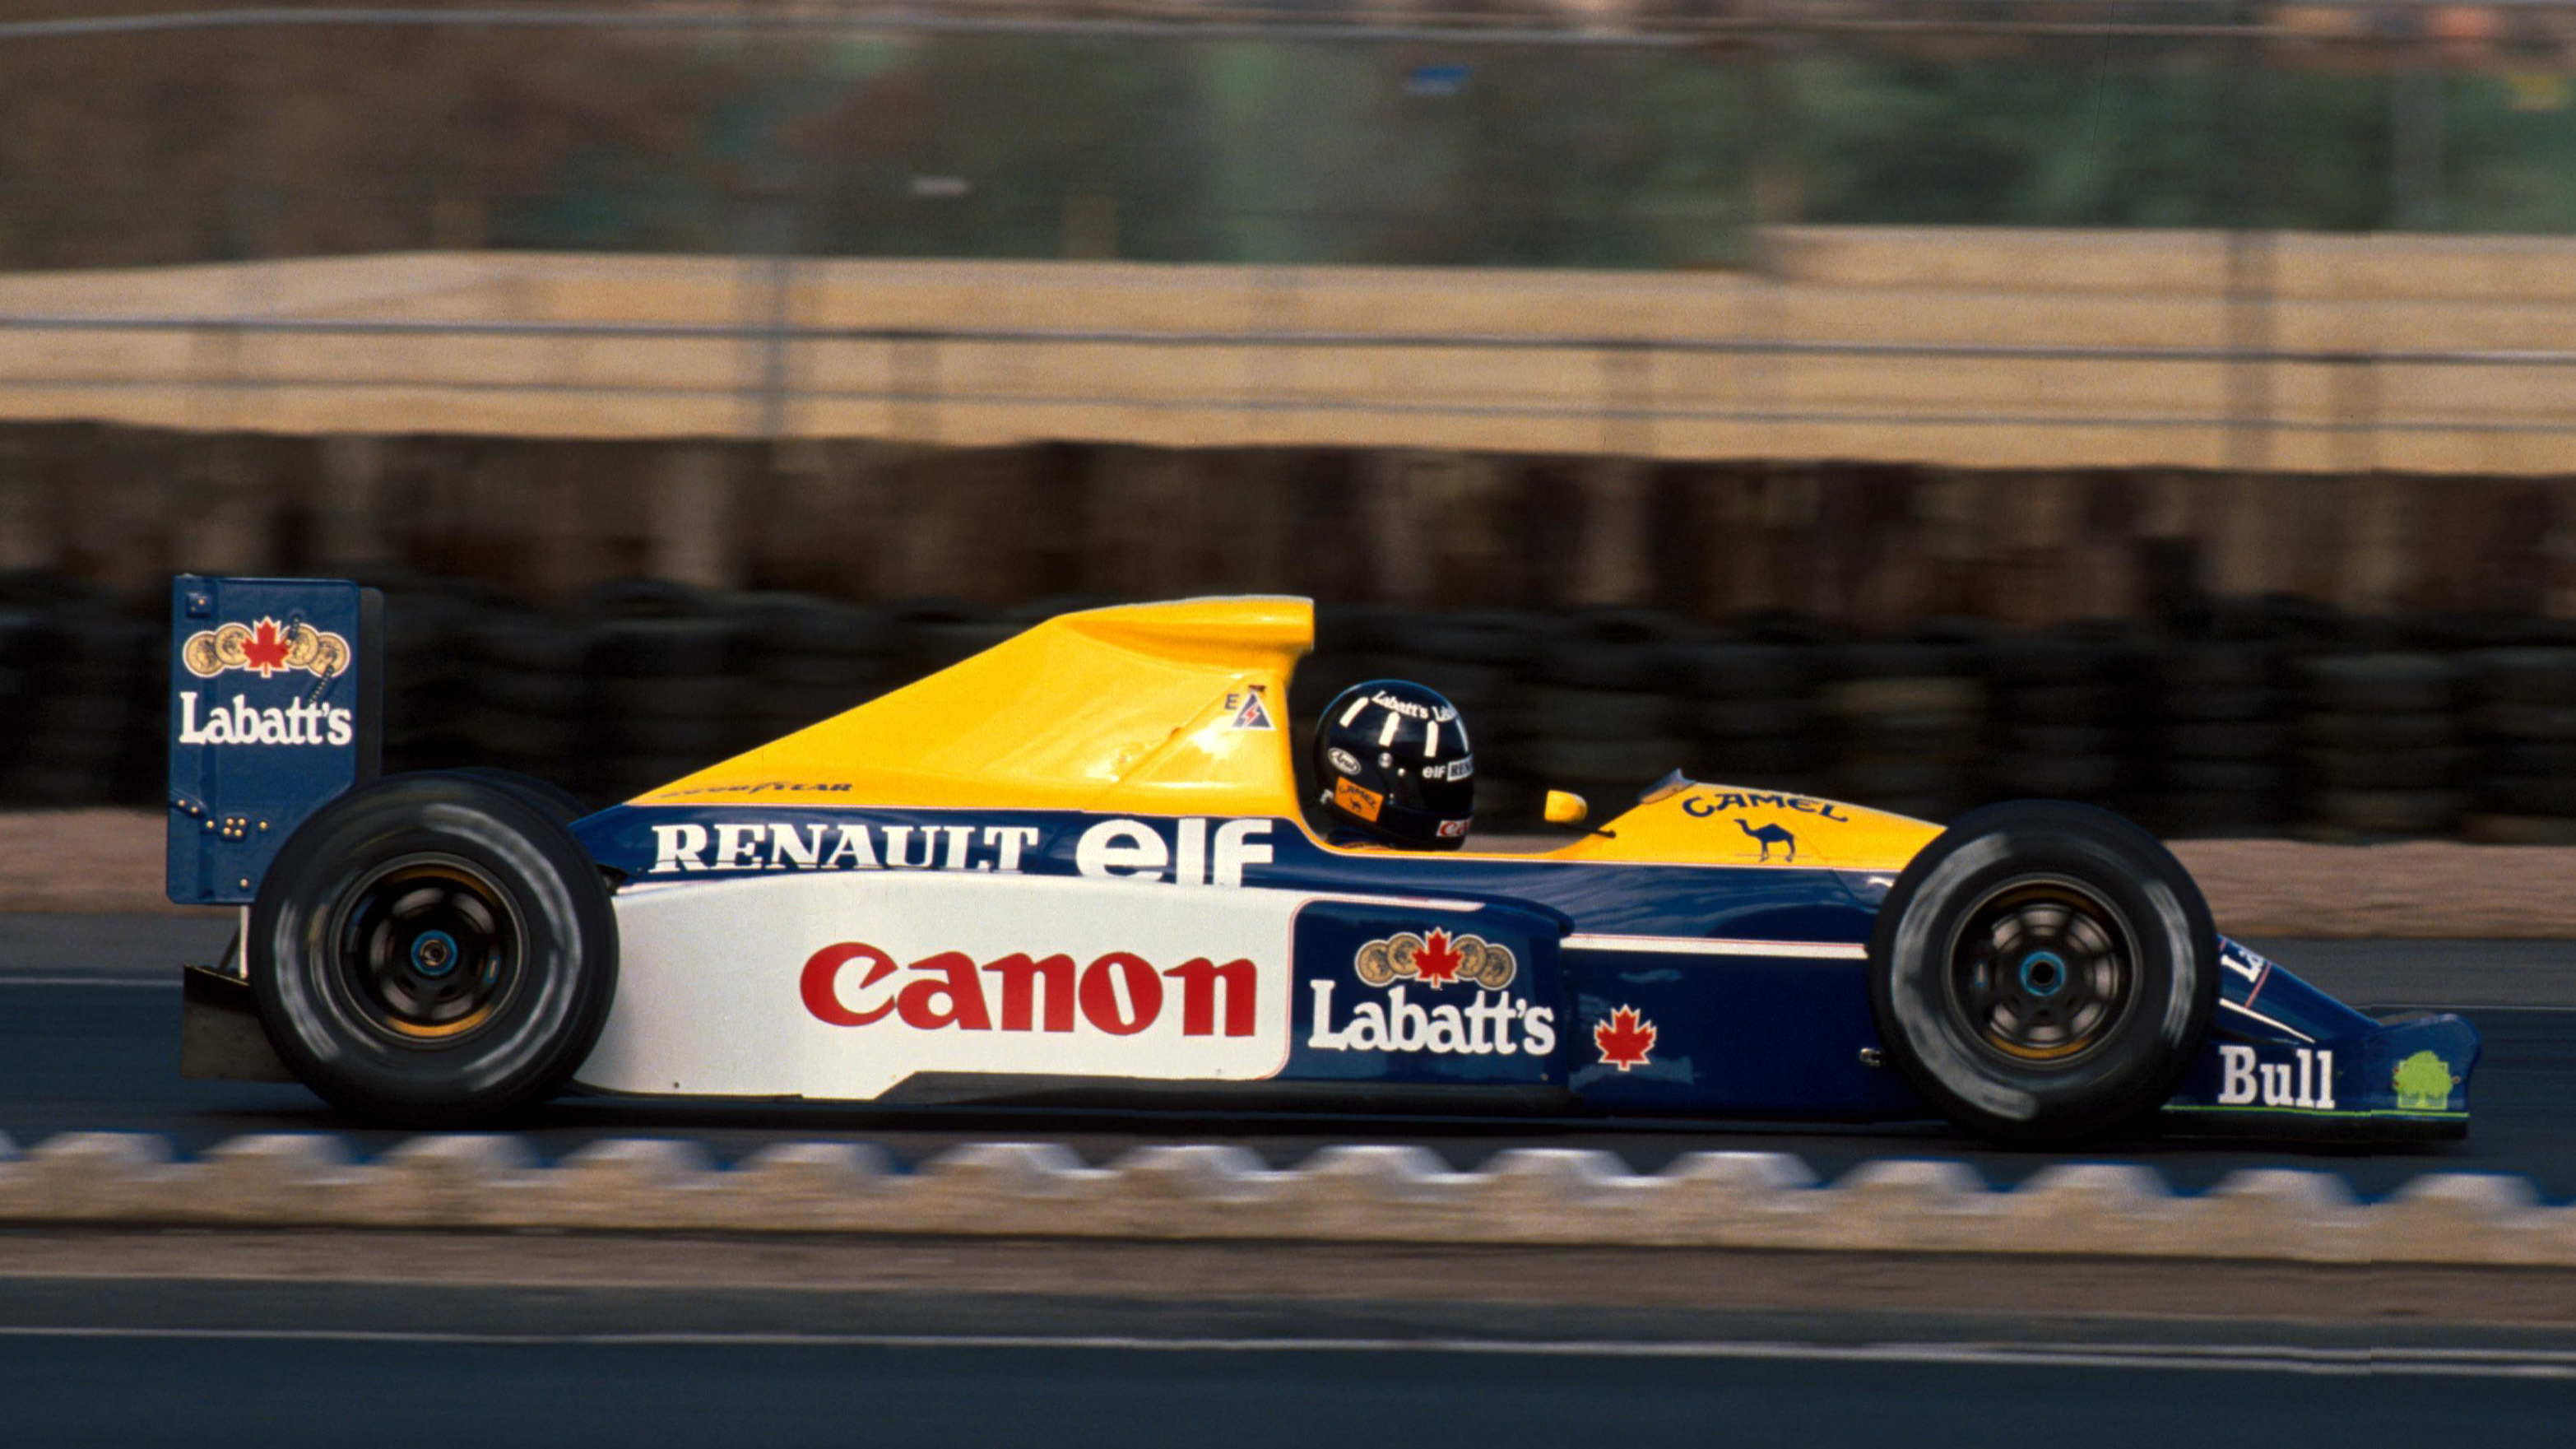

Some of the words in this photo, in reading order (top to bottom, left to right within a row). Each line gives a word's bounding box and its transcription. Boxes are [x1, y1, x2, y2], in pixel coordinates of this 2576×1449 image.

[179, 691, 352, 745] Labatt's
[1224, 694, 1240, 709] E
[1372, 690, 1429, 719] Labatt's
[1423, 766, 1446, 778] elf
[1683, 793, 1848, 822] CAMEL
[648, 824, 1039, 874] RENAULT
[1076, 818, 1273, 887] elf
[800, 941, 1257, 1038] Canon
[1308, 979, 1556, 1055] Labatt's
[2217, 1044, 2336, 1109] Bull
